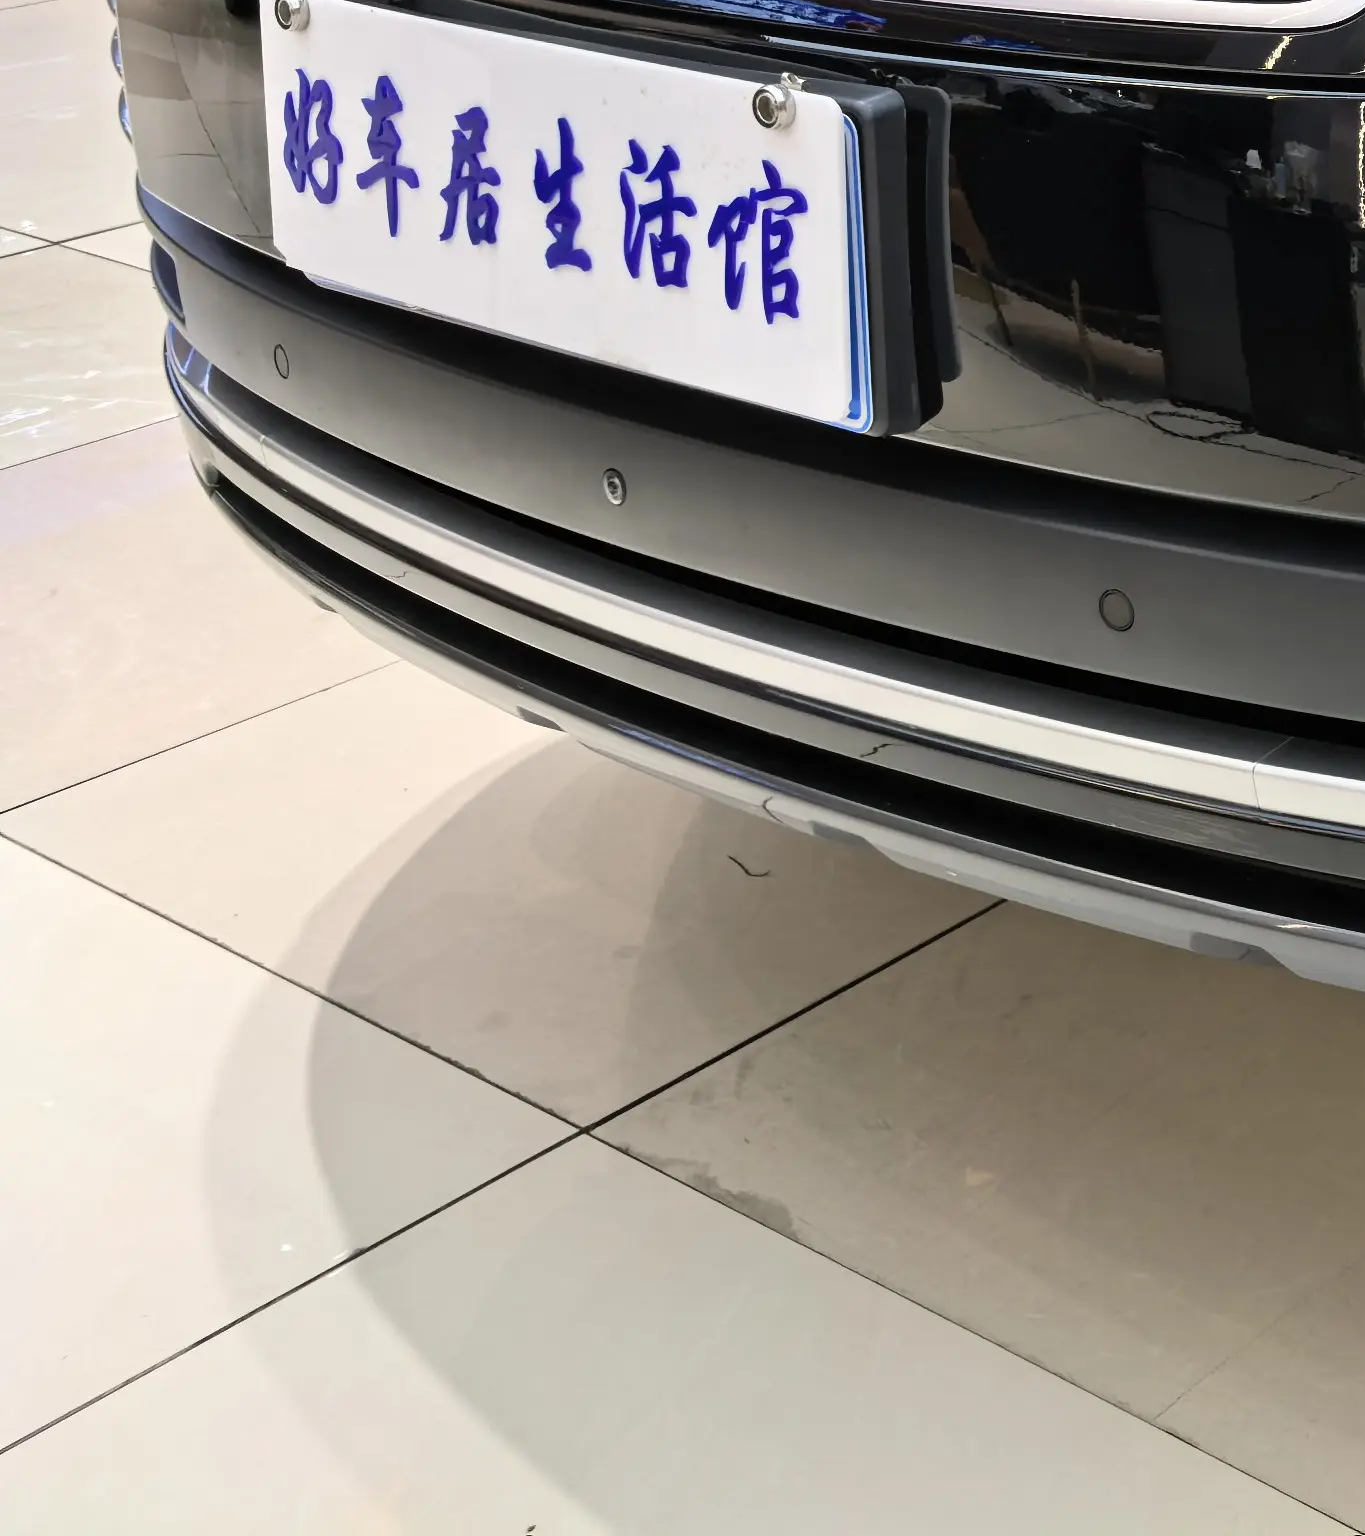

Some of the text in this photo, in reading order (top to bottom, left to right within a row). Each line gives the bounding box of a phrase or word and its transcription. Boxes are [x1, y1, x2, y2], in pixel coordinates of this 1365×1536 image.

[283, 67, 809, 325] 好车居生活馆
